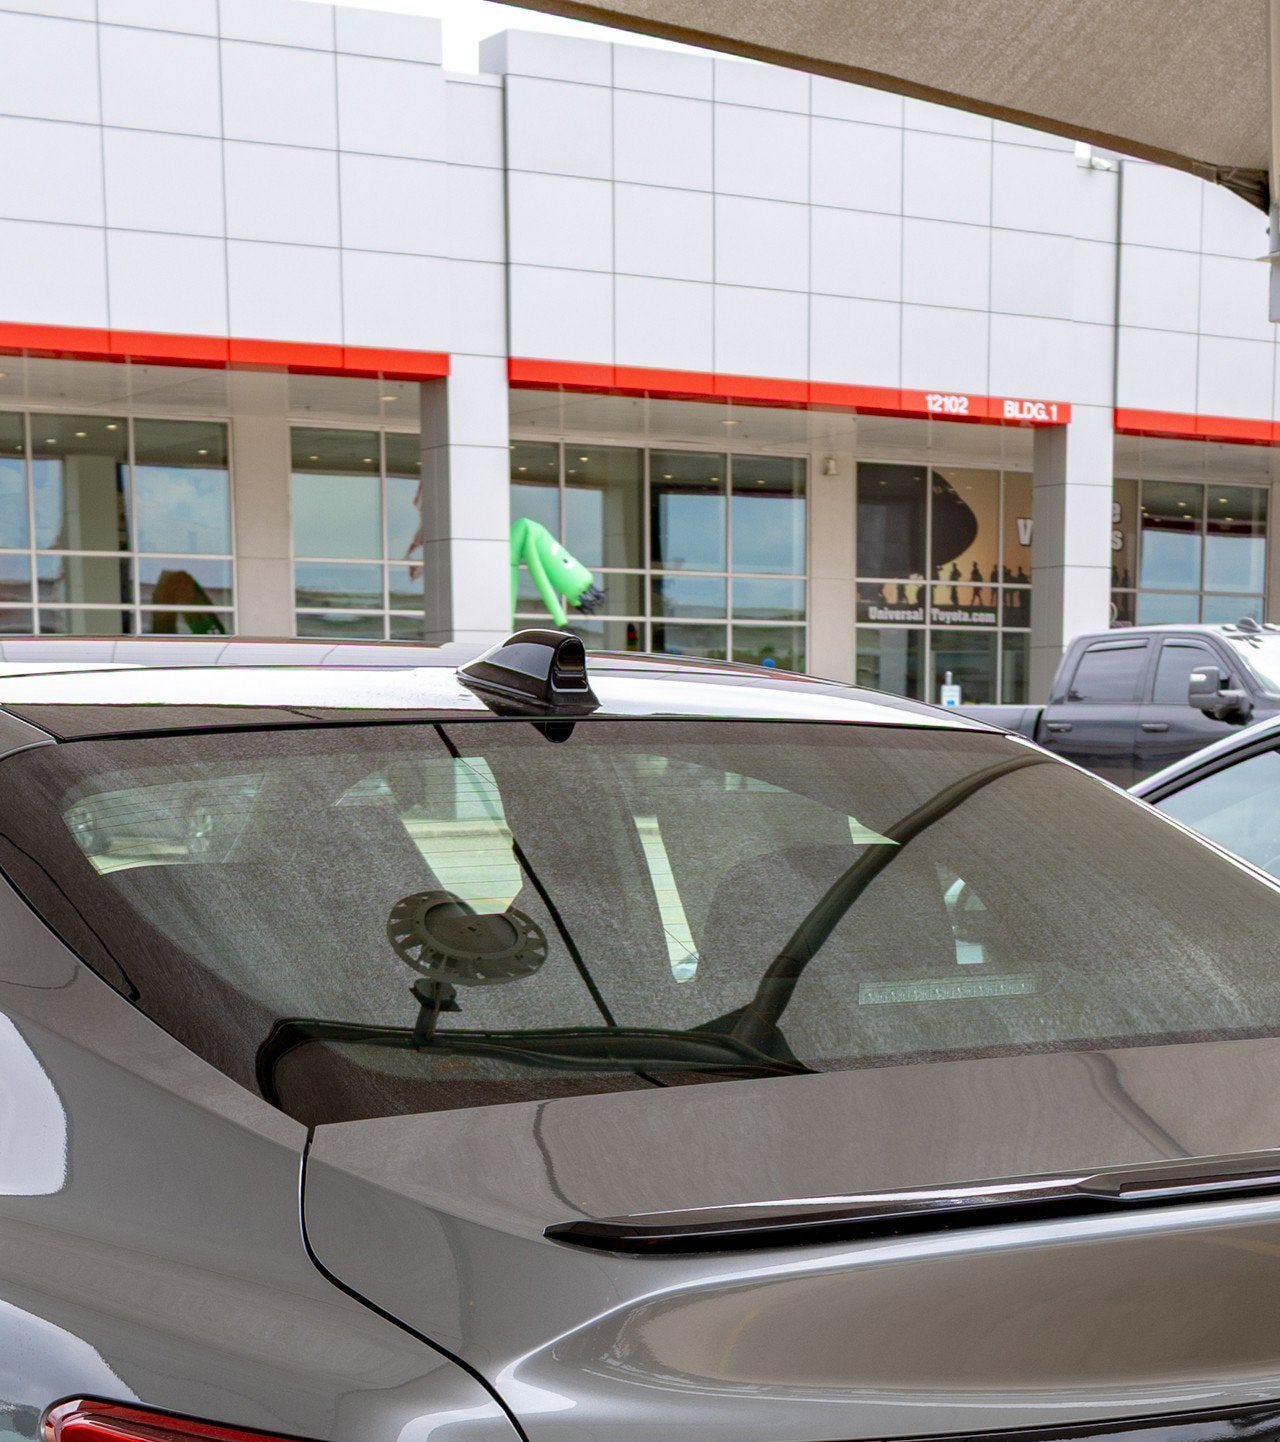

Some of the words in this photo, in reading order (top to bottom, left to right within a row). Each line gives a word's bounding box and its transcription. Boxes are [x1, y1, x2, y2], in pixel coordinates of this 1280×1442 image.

[925, 393, 969, 415] 12102
[1003, 399, 1049, 420] BLDG.
[1050, 404, 1058, 421] 1
[868, 605, 924, 621] Universal
[931, 607, 996, 624] Toyota.com
